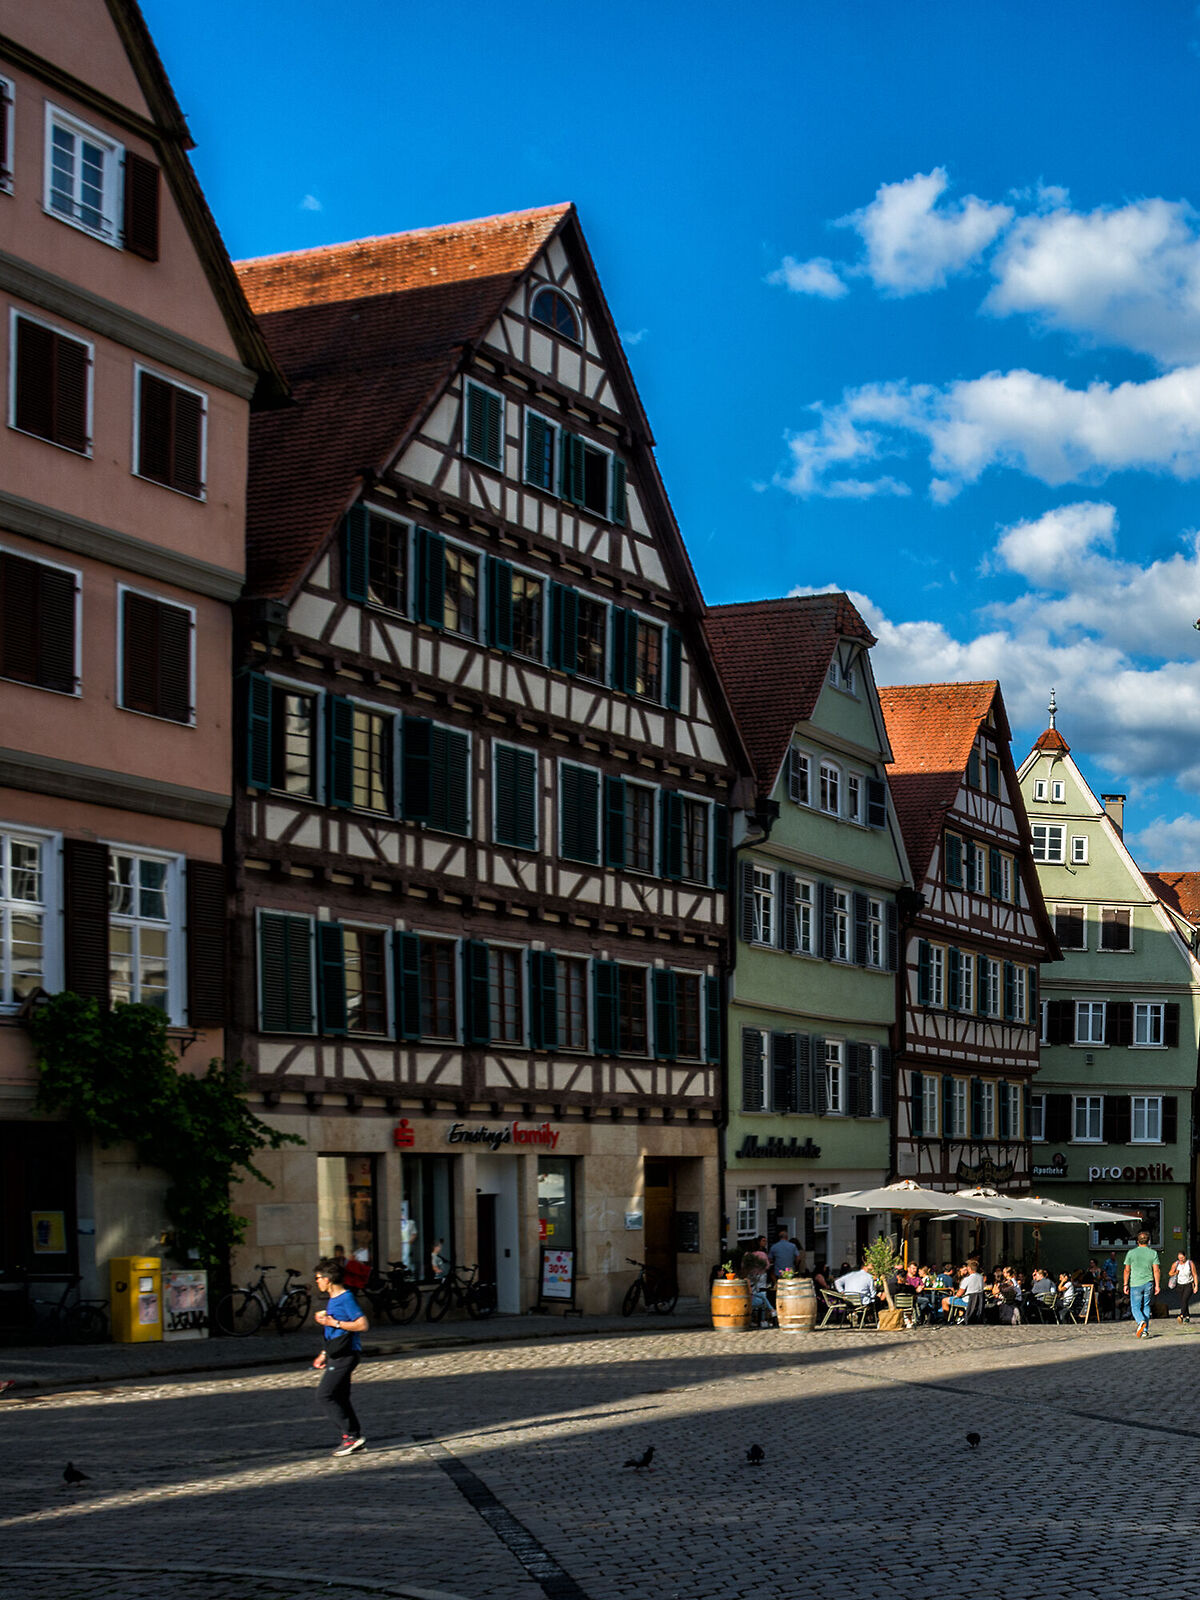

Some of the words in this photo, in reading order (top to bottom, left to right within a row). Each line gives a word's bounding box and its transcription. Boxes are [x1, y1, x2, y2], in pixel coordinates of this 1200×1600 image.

[448, 1123, 510, 1150] Ernsting's
[513, 1121, 560, 1149] family
[1032, 1166, 1065, 1177] Apotheke
